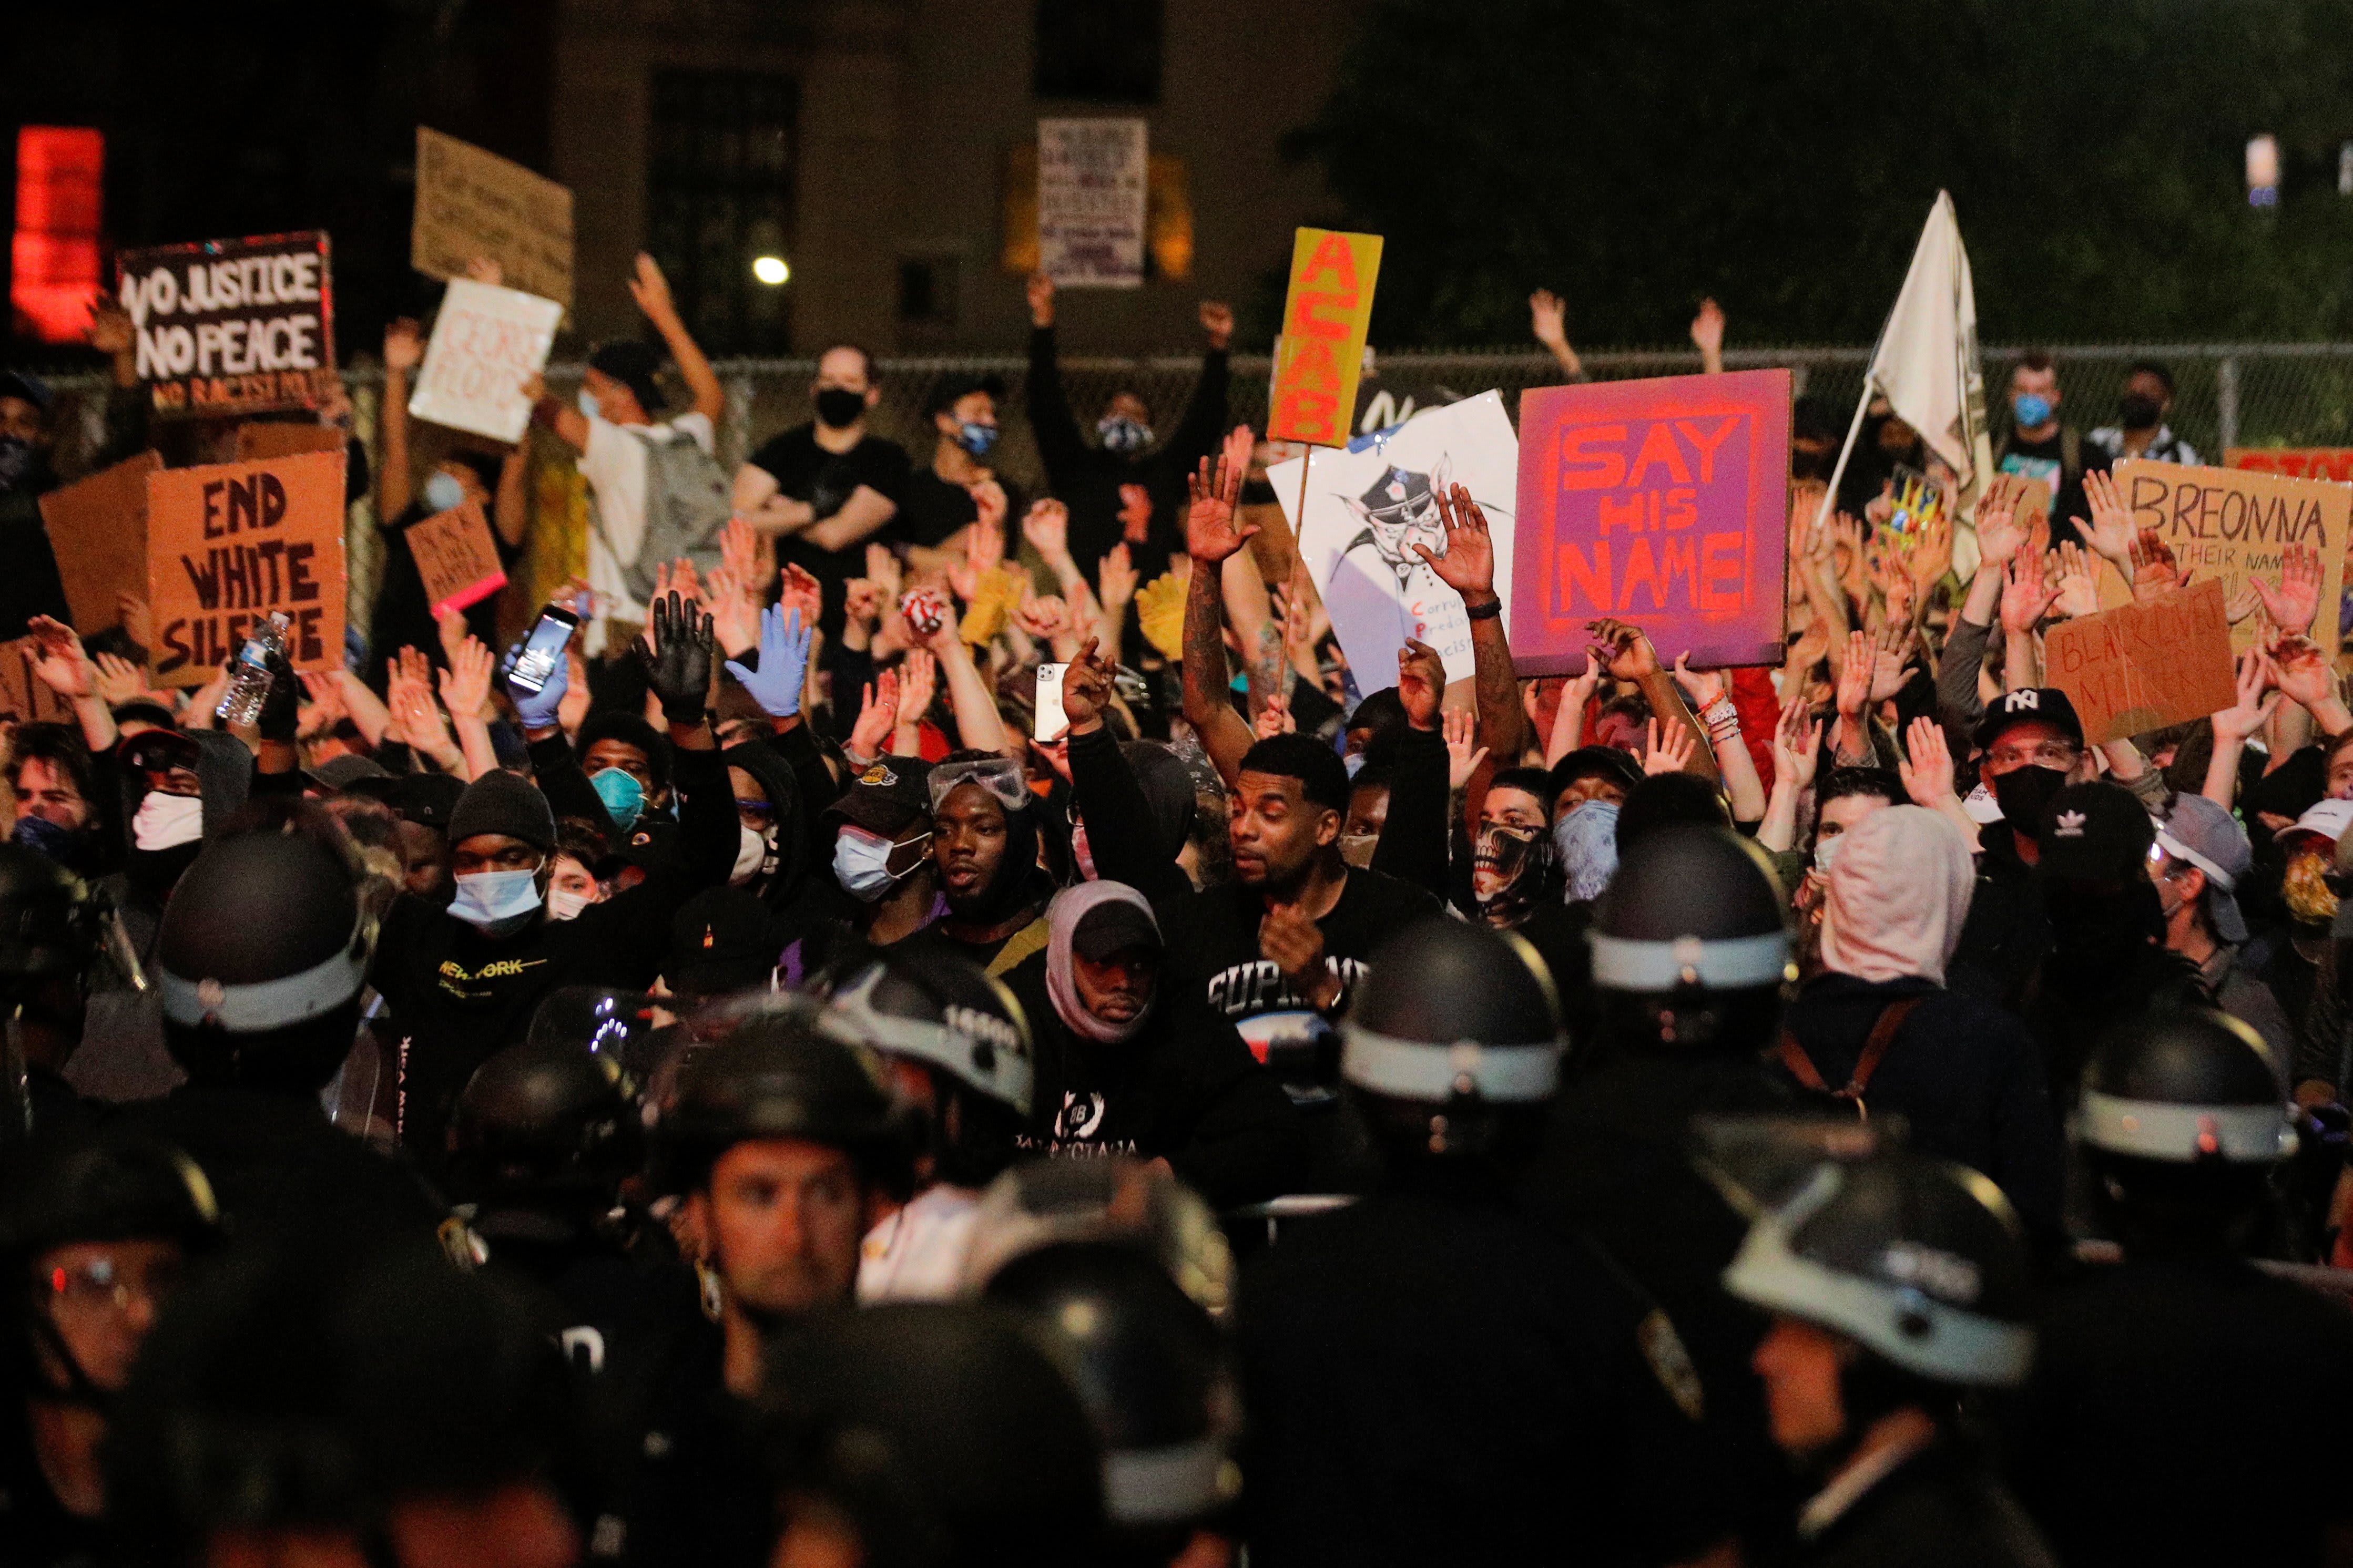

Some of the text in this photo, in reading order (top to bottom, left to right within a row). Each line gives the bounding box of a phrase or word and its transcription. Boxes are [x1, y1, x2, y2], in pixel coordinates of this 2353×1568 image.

[119, 252, 321, 327] NO JUSTICE
[136, 314, 319, 380] NO PEACE
[1277, 233, 1359, 442] ACAB
[1562, 417, 1740, 490] SAY
[202, 473, 287, 539] END
[1599, 488, 1697, 536] HIS
[2130, 476, 2326, 548] BREONNA
[181, 540, 320, 610] WHITE
[1558, 531, 1744, 612] NAME
[2175, 542, 2289, 571] THEIR NAM
[1411, 597, 1465, 617] Corrup
